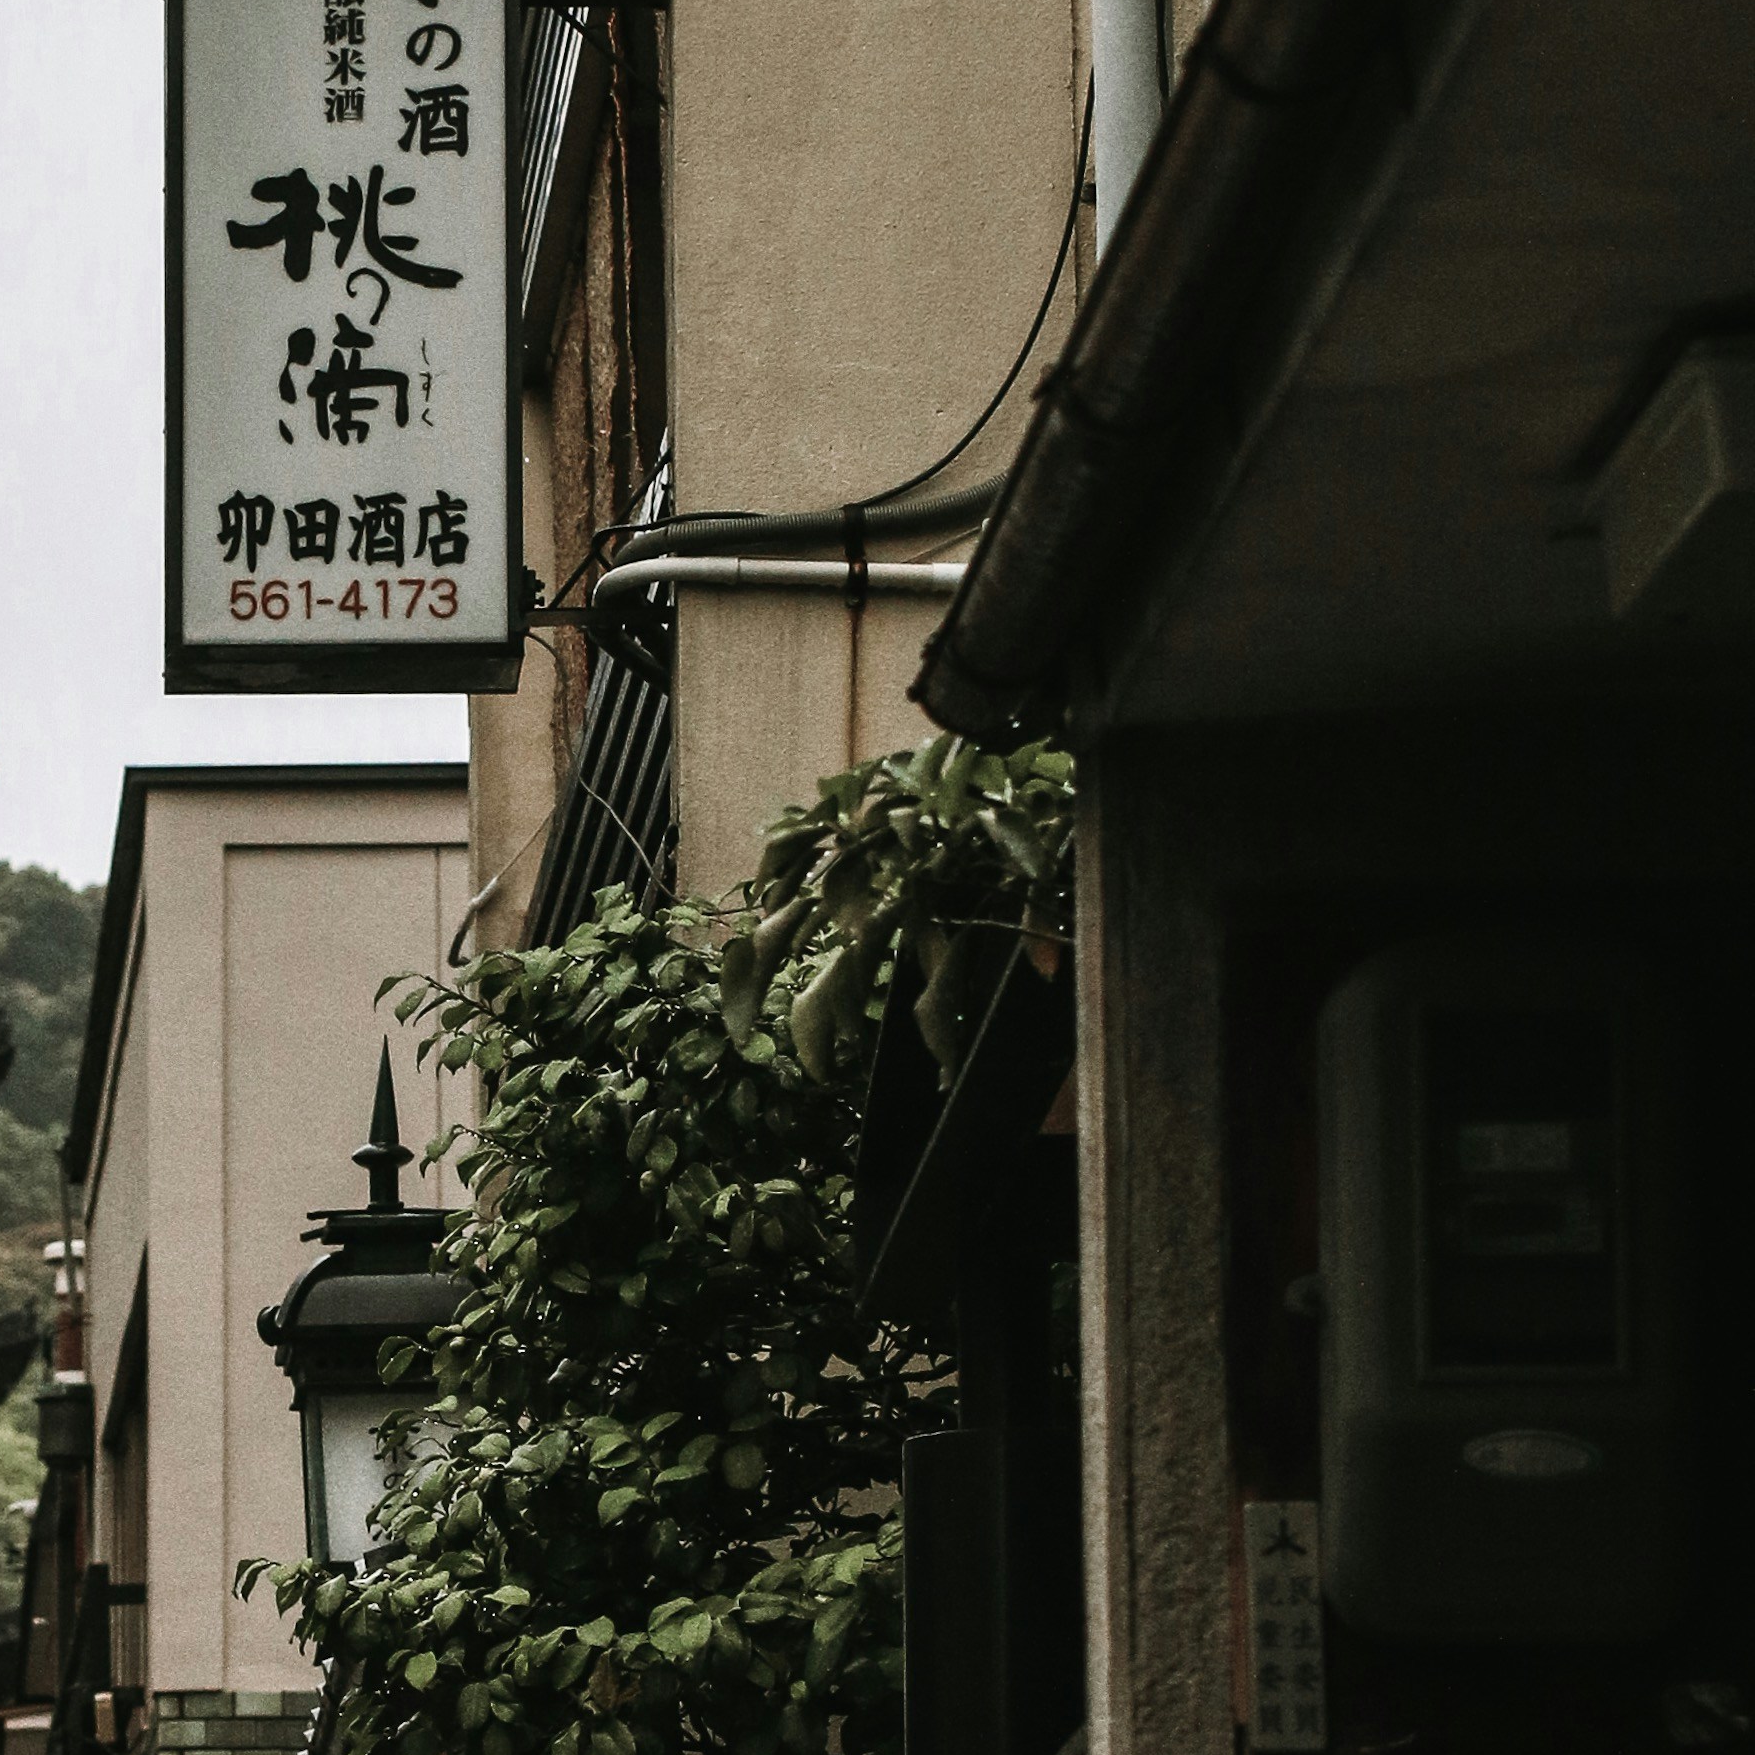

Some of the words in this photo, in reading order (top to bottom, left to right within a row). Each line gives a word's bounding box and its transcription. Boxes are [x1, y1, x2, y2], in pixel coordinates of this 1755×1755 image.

[216, 489, 470, 574] 卯田酒店
[229, 578, 459, 622] 561-4173
